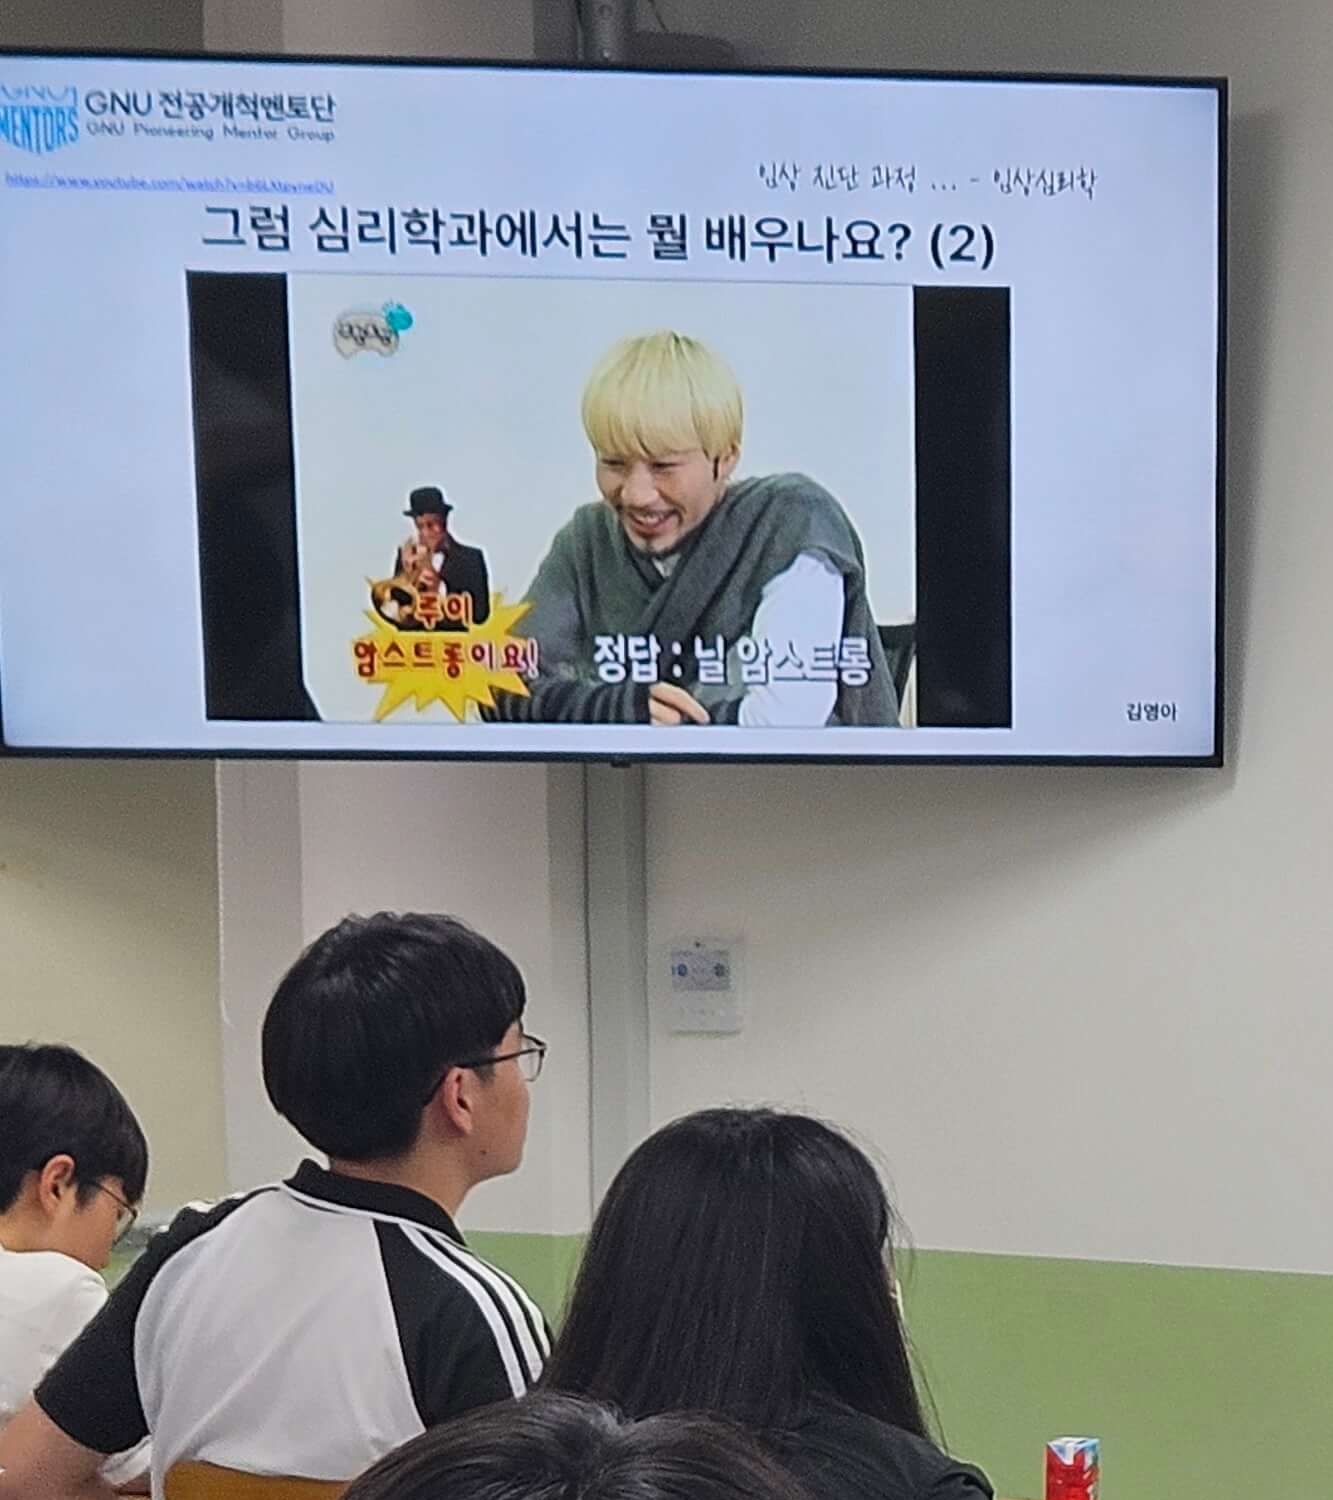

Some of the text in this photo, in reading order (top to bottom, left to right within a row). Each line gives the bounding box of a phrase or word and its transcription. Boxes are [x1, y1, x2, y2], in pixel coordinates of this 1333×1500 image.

[85, 91, 151, 116] GNU
[86, 121, 125, 137] GNU
[288, 127, 335, 144] Group
[202, 204, 995, 271] 그럼 심리학과에서는 뭘 배우나요? (2)
[593, 634, 662, 683] 정답
[694, 636, 728, 685] 닐
[738, 636, 873, 687] 암스트롱
